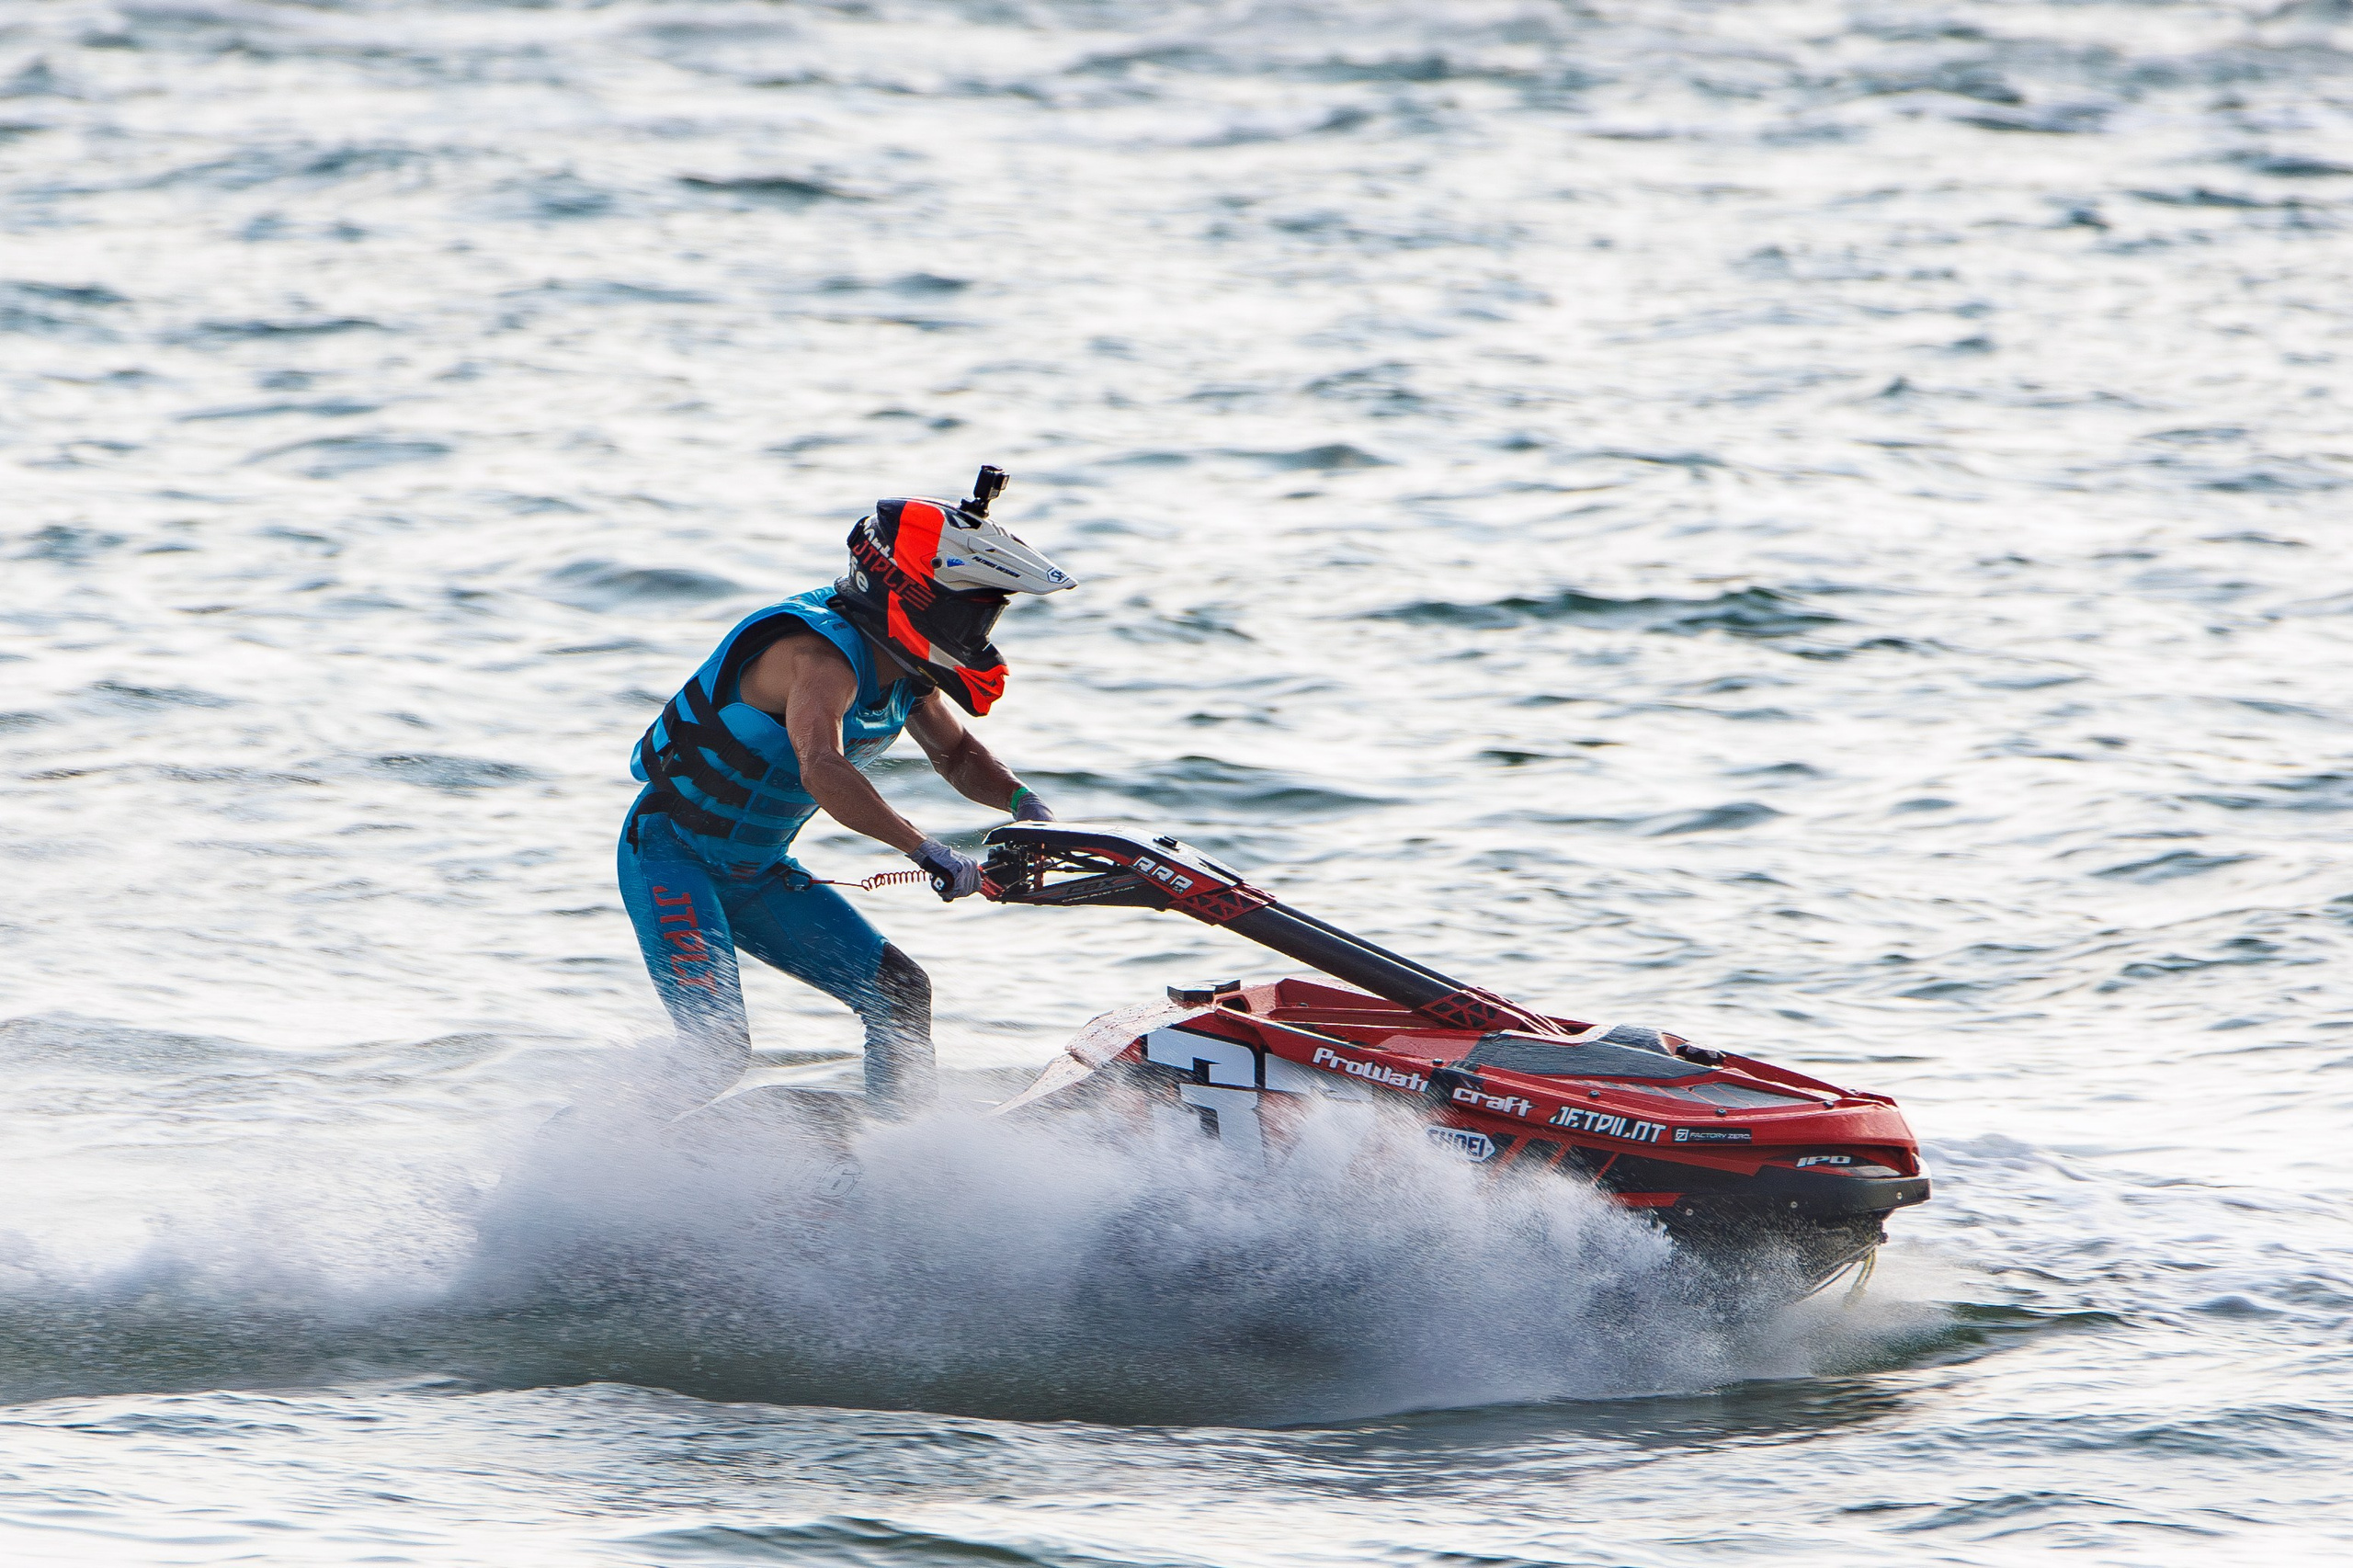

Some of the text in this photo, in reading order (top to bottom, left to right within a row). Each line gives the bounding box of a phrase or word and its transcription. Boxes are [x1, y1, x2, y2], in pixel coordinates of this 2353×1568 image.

[852, 540, 916, 595] JTPLT
[653, 885, 718, 995] JTPLT
[1452, 1087, 1534, 1118] craft
[1549, 1106, 1667, 1143] JETPILOT
